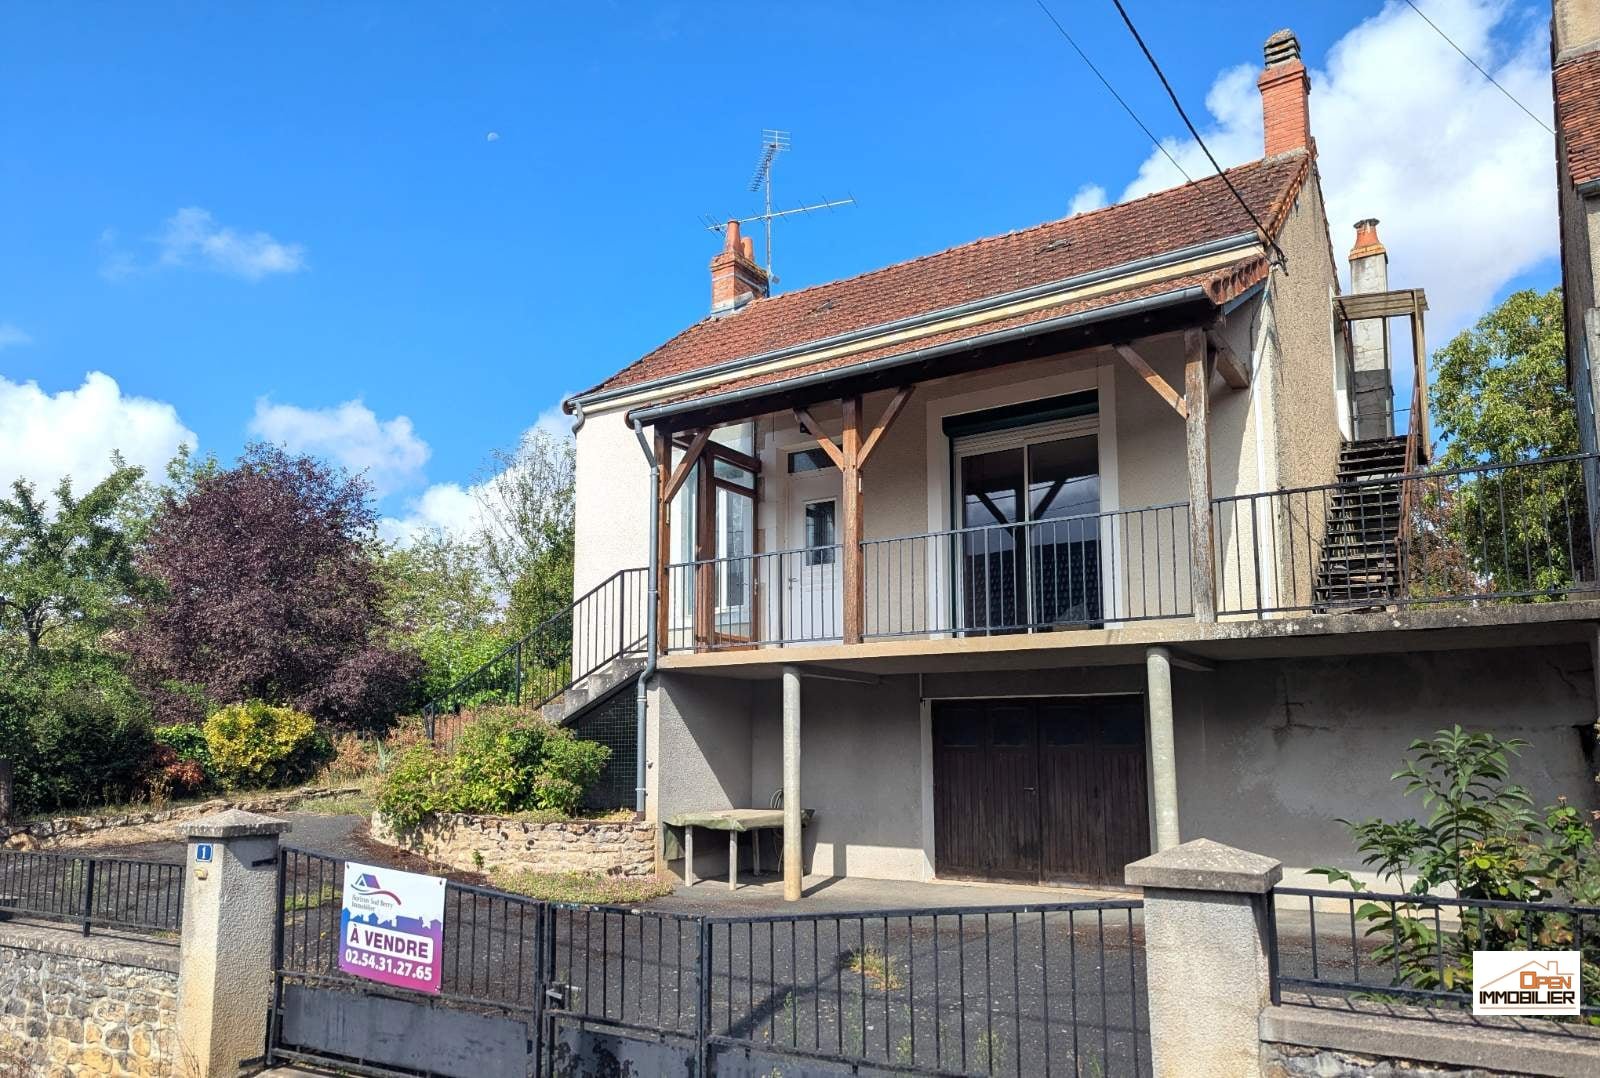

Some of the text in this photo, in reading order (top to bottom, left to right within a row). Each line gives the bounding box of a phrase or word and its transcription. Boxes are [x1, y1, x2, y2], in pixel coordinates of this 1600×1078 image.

[201, 846, 206, 859] 1
[380, 899, 393, 908] Berry
[350, 923, 429, 959] À VENDRE
[345, 949, 432, 981] 02.54.31.27.65
